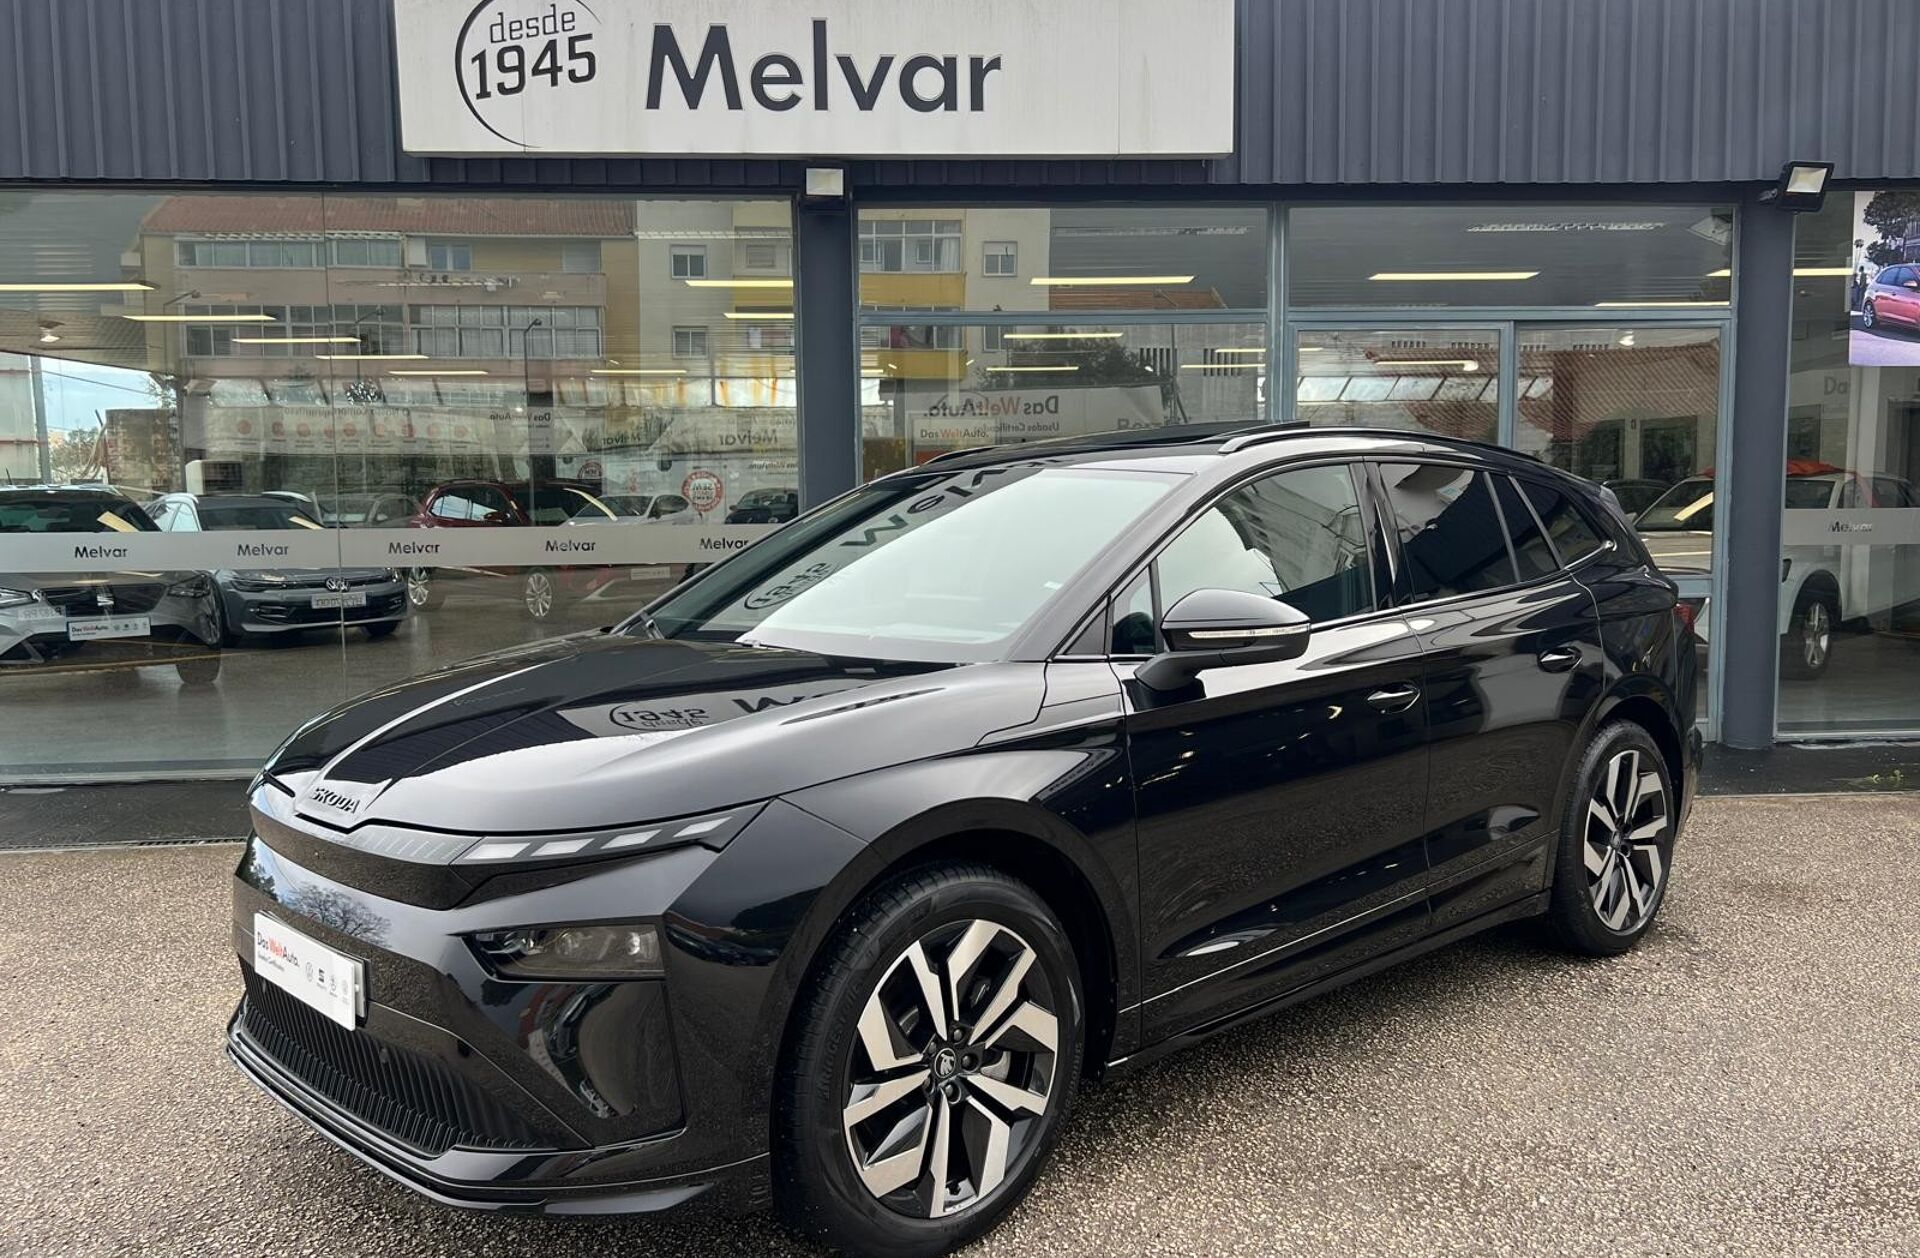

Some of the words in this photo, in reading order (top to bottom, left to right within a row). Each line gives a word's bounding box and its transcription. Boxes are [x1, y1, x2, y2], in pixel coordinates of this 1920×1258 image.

[488, 6, 577, 45] desde
[469, 34, 597, 101] 1945
[645, 19, 1003, 112] Melvar
[1824, 375, 1850, 396] Da
[920, 429, 939, 439] Das
[237, 542, 290, 557] Melvar
[388, 541, 442, 555] Melvar
[545, 539, 598, 552] Melvar
[698, 537, 749, 550] Melvar
[74, 544, 128, 559] Melvar
[257, 931, 269, 950] Das
